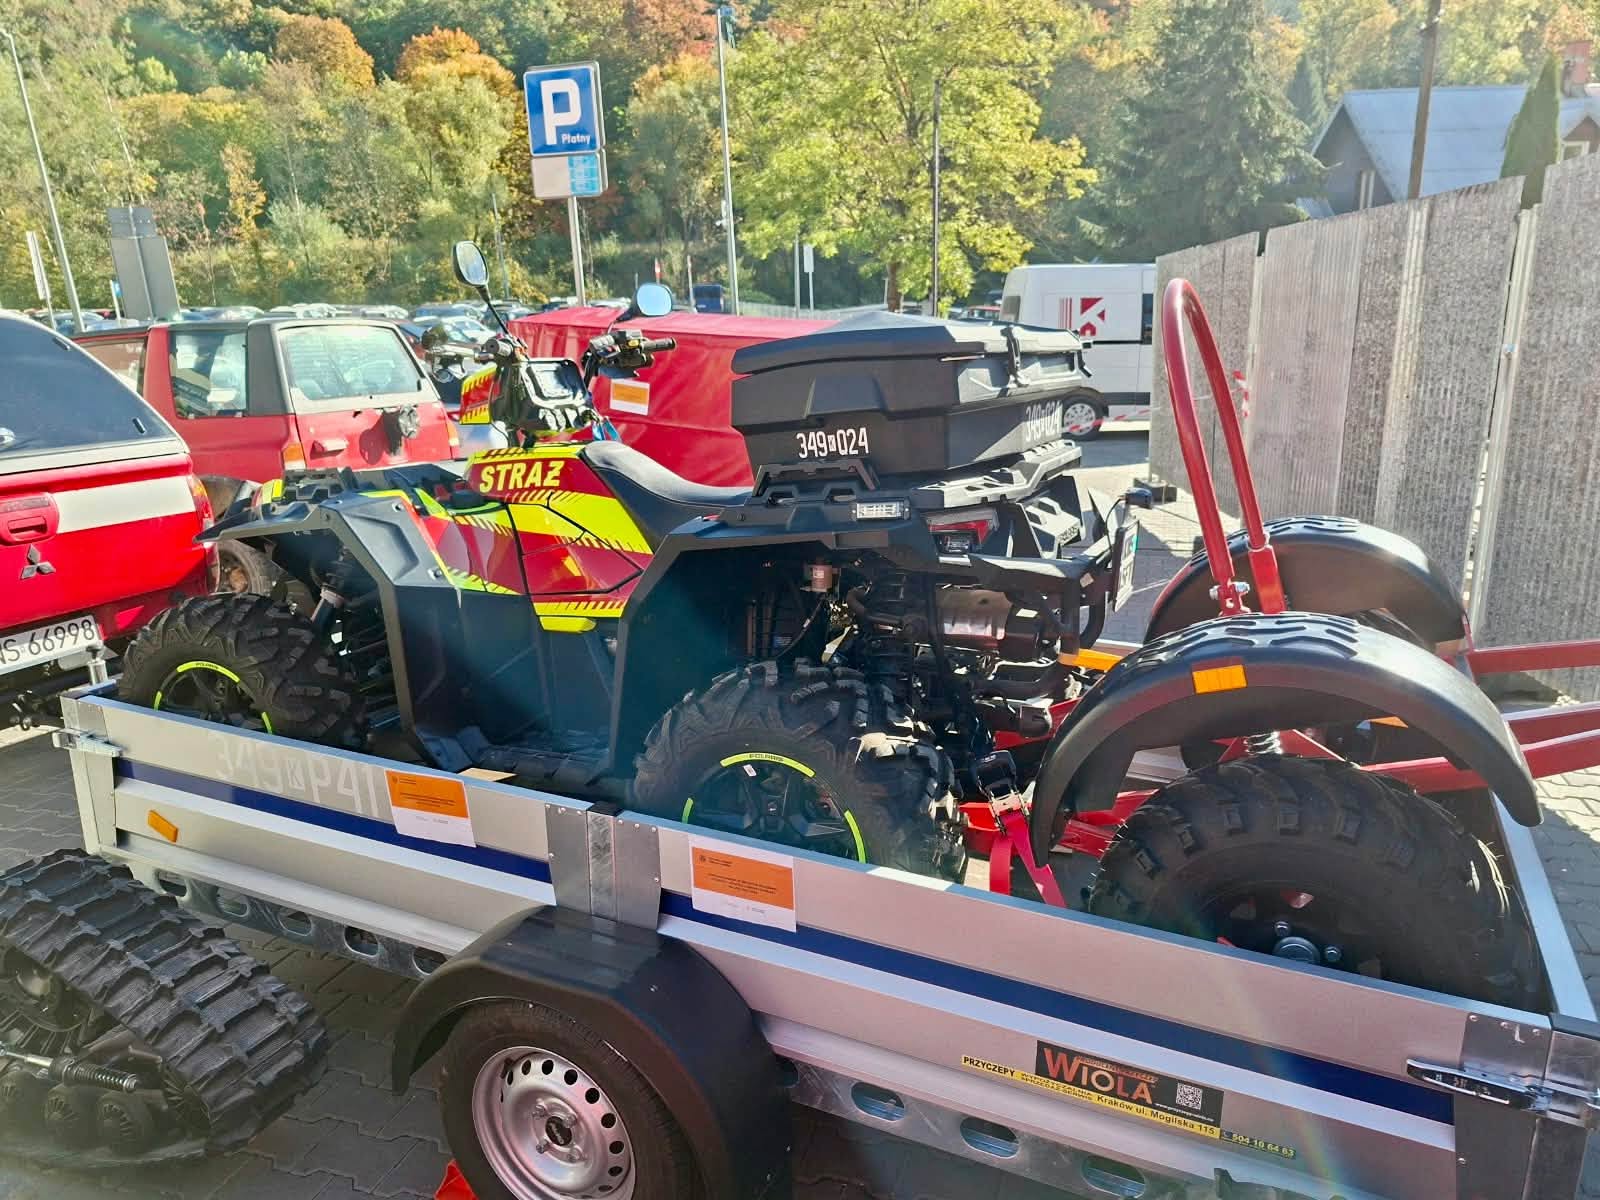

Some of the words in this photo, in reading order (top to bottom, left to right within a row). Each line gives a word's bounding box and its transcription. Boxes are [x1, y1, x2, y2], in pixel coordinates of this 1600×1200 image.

[541, 79, 581, 145] P
[28, 619, 95, 655] 66998
[963, 1056, 1016, 1077] PRZYCZEPY
[1043, 1047, 1153, 1105] WIOLA
[1150, 1109, 1195, 1130] Mogilska
[1198, 1124, 1216, 1135] 115
